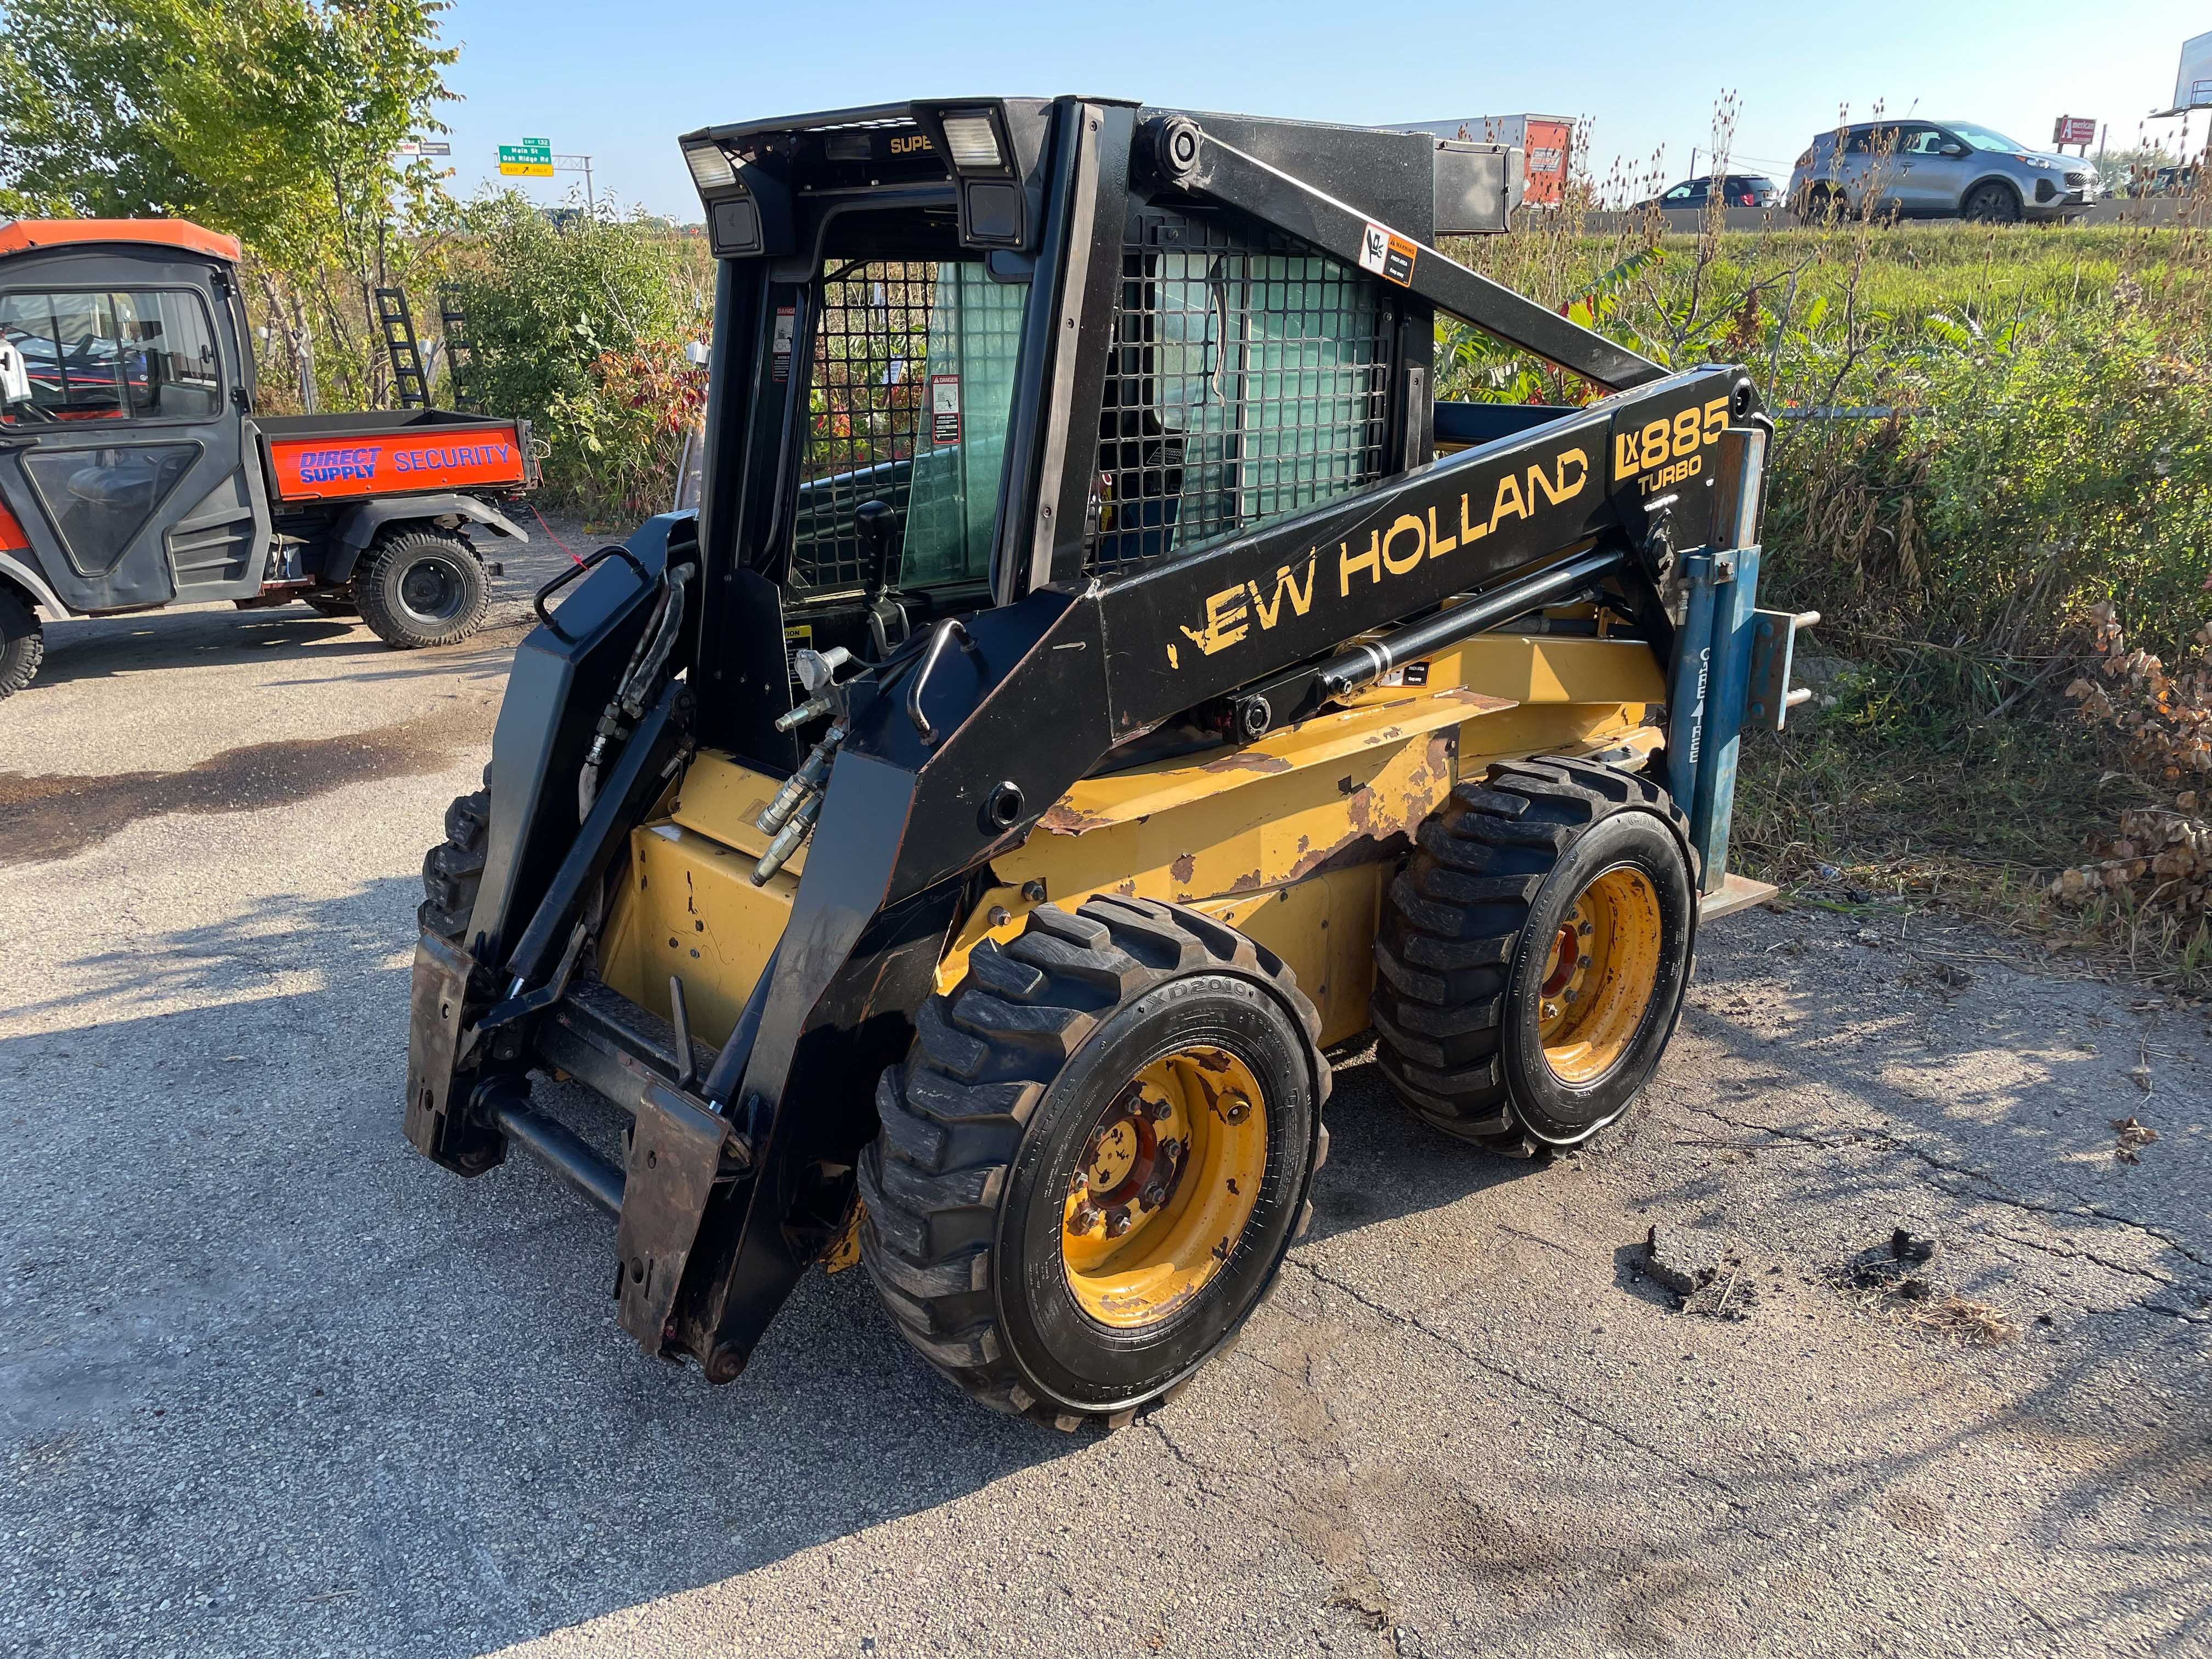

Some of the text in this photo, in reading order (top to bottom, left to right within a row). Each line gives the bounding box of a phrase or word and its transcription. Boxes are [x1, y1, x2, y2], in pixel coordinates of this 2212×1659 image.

[891, 135, 934, 154] SUPE
[518, 155, 538, 163] Ridge
[300, 444, 509, 472] DIRECT SECURITY
[301, 464, 375, 483] SUPPLY
[1638, 455, 1701, 495] TURBO
[1340, 448, 1588, 597] HOLLAND
[1147, 978, 1247, 1011] XD2010
